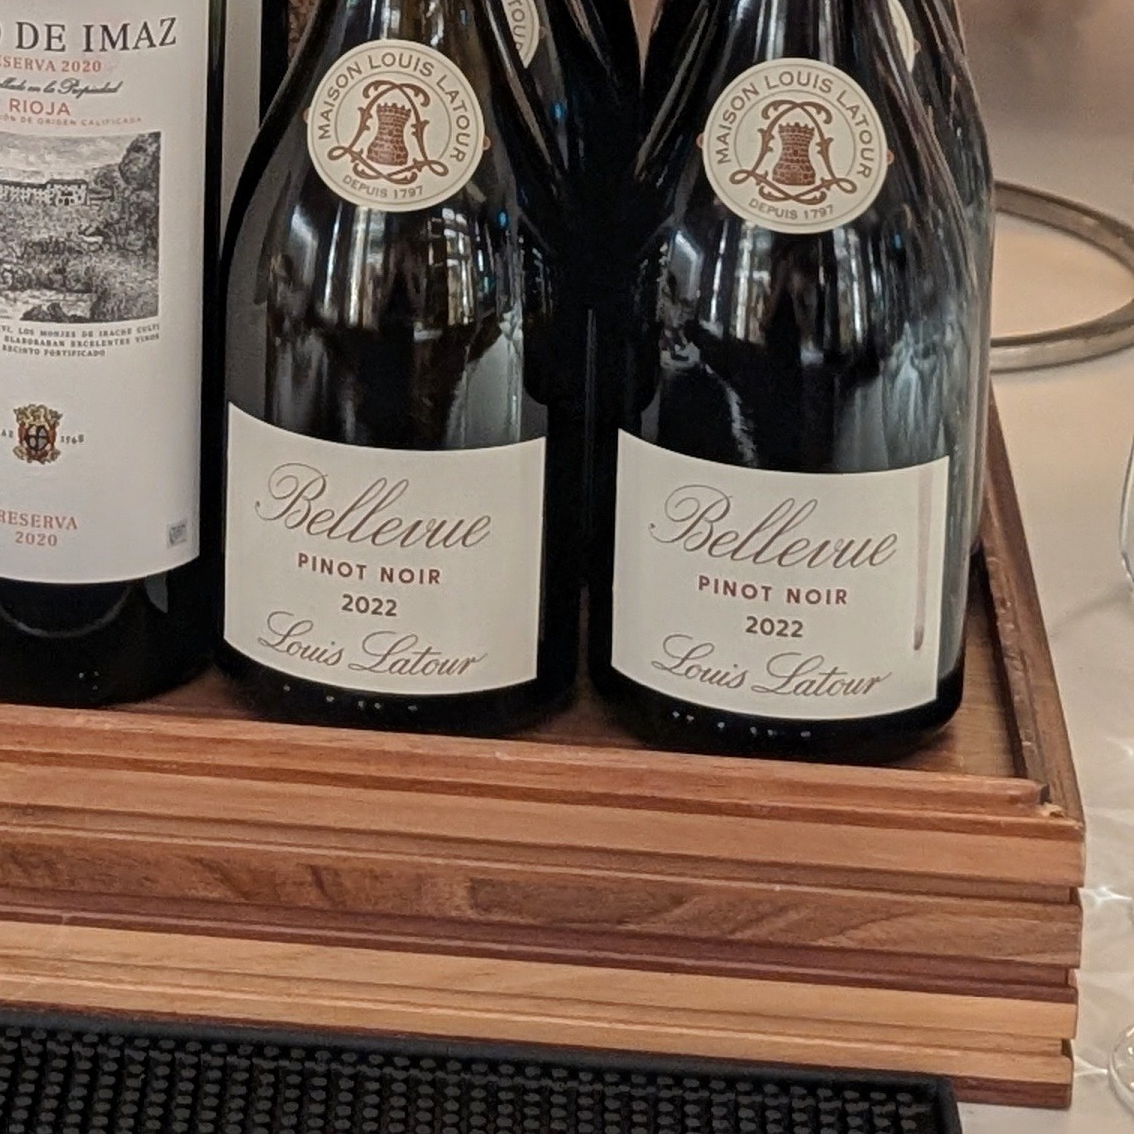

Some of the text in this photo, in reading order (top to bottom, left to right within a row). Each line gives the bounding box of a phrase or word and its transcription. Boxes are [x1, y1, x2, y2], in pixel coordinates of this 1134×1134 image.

[16, 21, 66, 52] DE
[83, 17, 177, 53] IMAZ
[62, 59, 102, 73] 2020
[9, 97, 71, 116] RIOJA
[20, 115, 33, 124] DE
[318, 52, 471, 163] MAISON LOUIS LATOUR
[717, 71, 875, 179] MAISON LOUIS LATOUR
[342, 174, 424, 200] DEPUIS 1797
[749, 198, 834, 220] DEPUIS 1797
[254, 462, 491, 549] Bellevue
[15, 531, 58, 547] 2020
[648, 484, 898, 569] Bellevue
[297, 552, 442, 585] PINOT NOIR
[341, 593, 398, 617] 2022
[698, 575, 848, 605] PINOT NOIR
[745, 616, 804, 638] 2022
[258, 611, 488, 676] Louis Latour
[651, 634, 892, 697] Louis Latour
